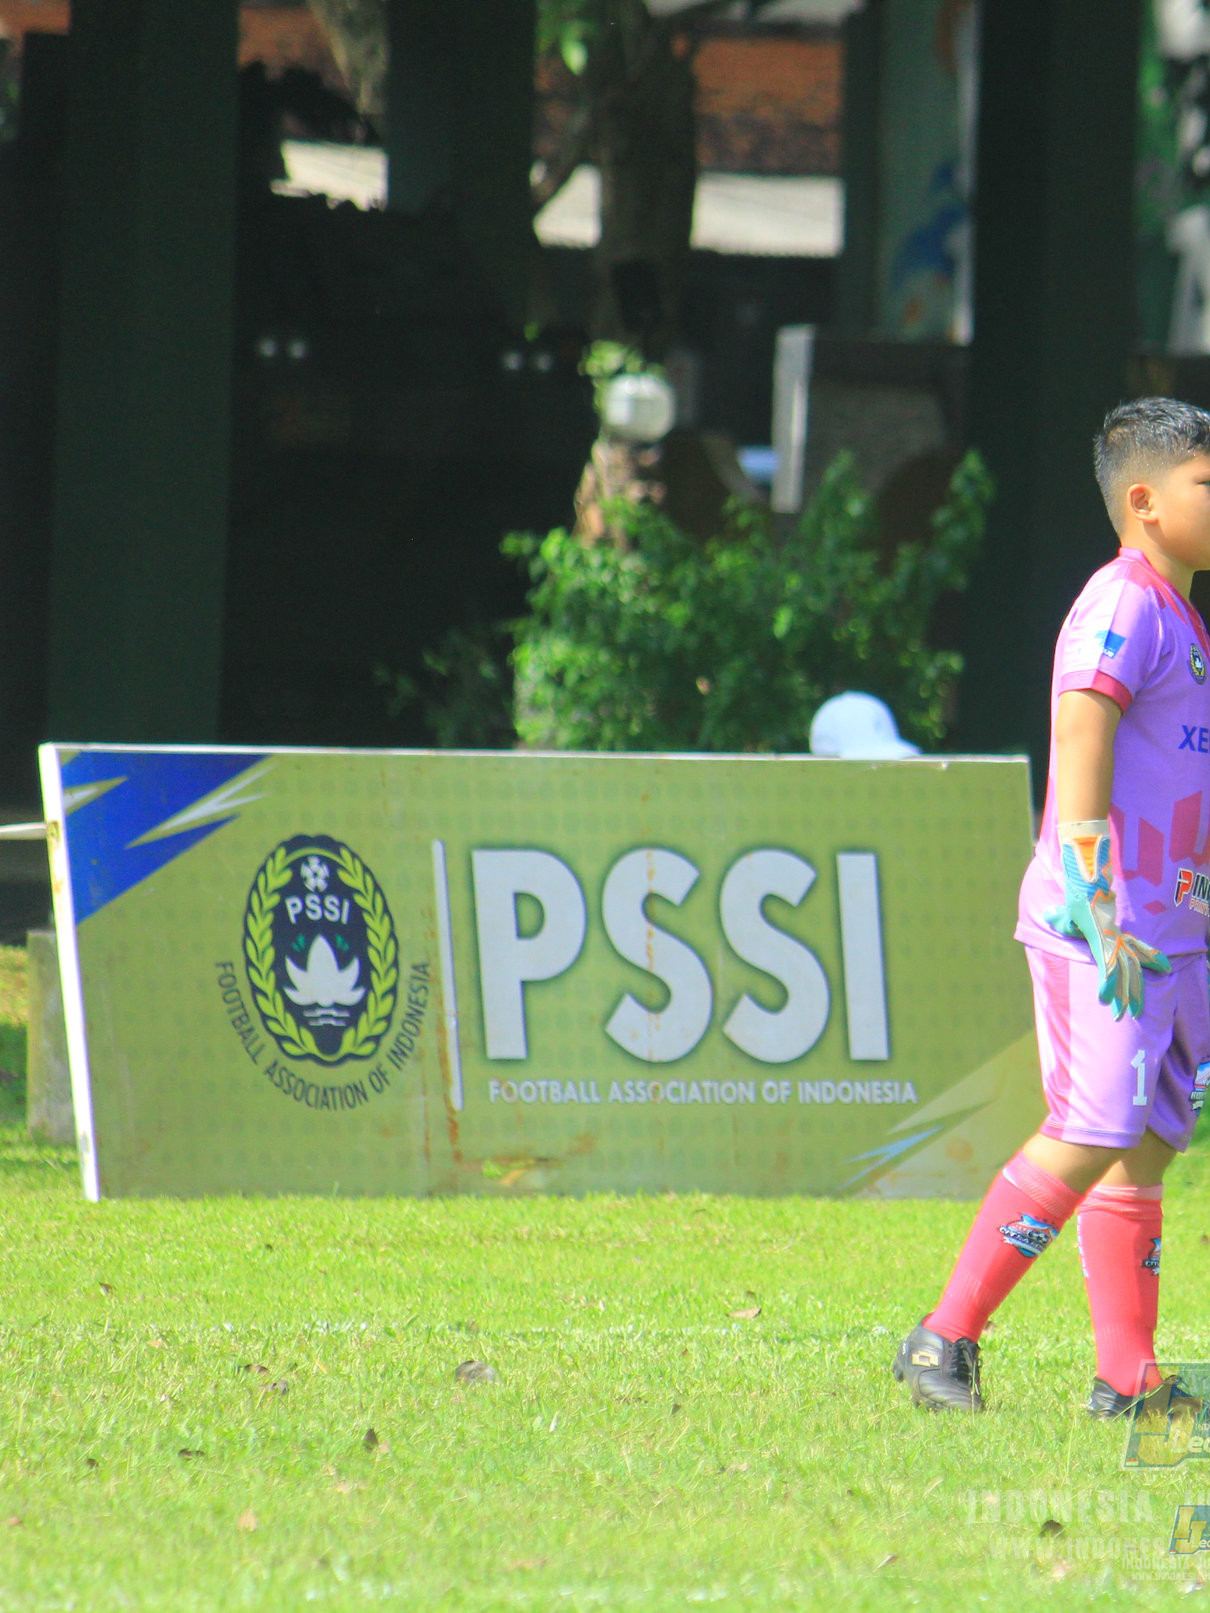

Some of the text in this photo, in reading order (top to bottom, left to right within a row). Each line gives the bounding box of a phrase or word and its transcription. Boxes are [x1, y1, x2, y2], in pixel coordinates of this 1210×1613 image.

[284, 893, 351, 925] PSSI
[471, 847, 889, 1063] PSSI
[214, 960, 431, 1112] FOOTBALL ASSOCIATION OF INDONESIA
[487, 1079, 919, 1105] FOOTBALL ASSOCIATION OF INDONESIA
[1130, 1049, 1148, 1106] 1
